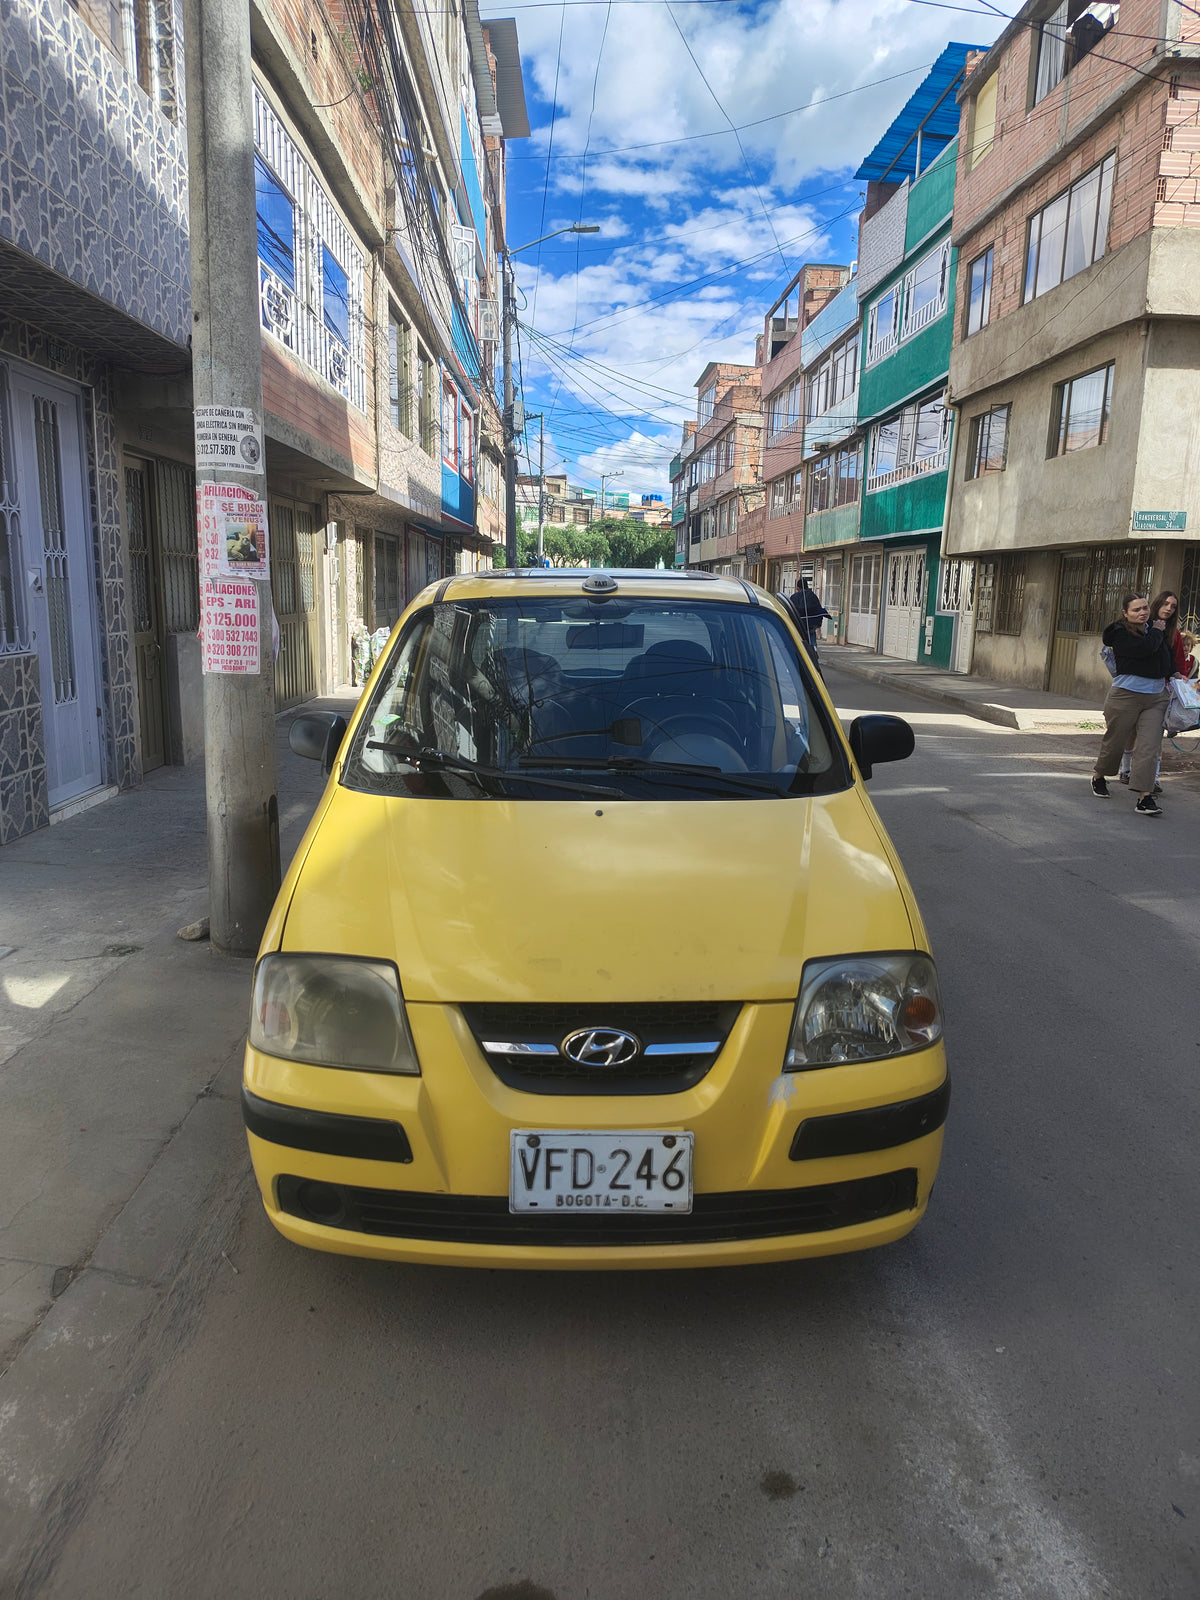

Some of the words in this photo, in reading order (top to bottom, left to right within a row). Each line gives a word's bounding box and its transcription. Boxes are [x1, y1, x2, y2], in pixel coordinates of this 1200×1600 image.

[236, 410, 244, 419] CON
[201, 444, 235, 455] 312.577.5878
[222, 503, 234, 512] SE
[238, 503, 263, 513] BUSCA
[1136, 512, 1166, 521] TRANSVERSAL
[206, 597, 224, 607] EPS
[235, 598, 256, 609] ARL
[206, 611, 211, 625] $
[214, 612, 256, 627] 125.000
[212, 629, 224, 641] 300
[226, 630, 240, 642] 532
[241, 631, 257, 642] 7443
[212, 644, 224, 655] 320
[226, 645, 241, 656] 308
[243, 645, 257, 656] 2171
[518, 1148, 595, 1190] VFD
[609, 1148, 685, 1190] 246
